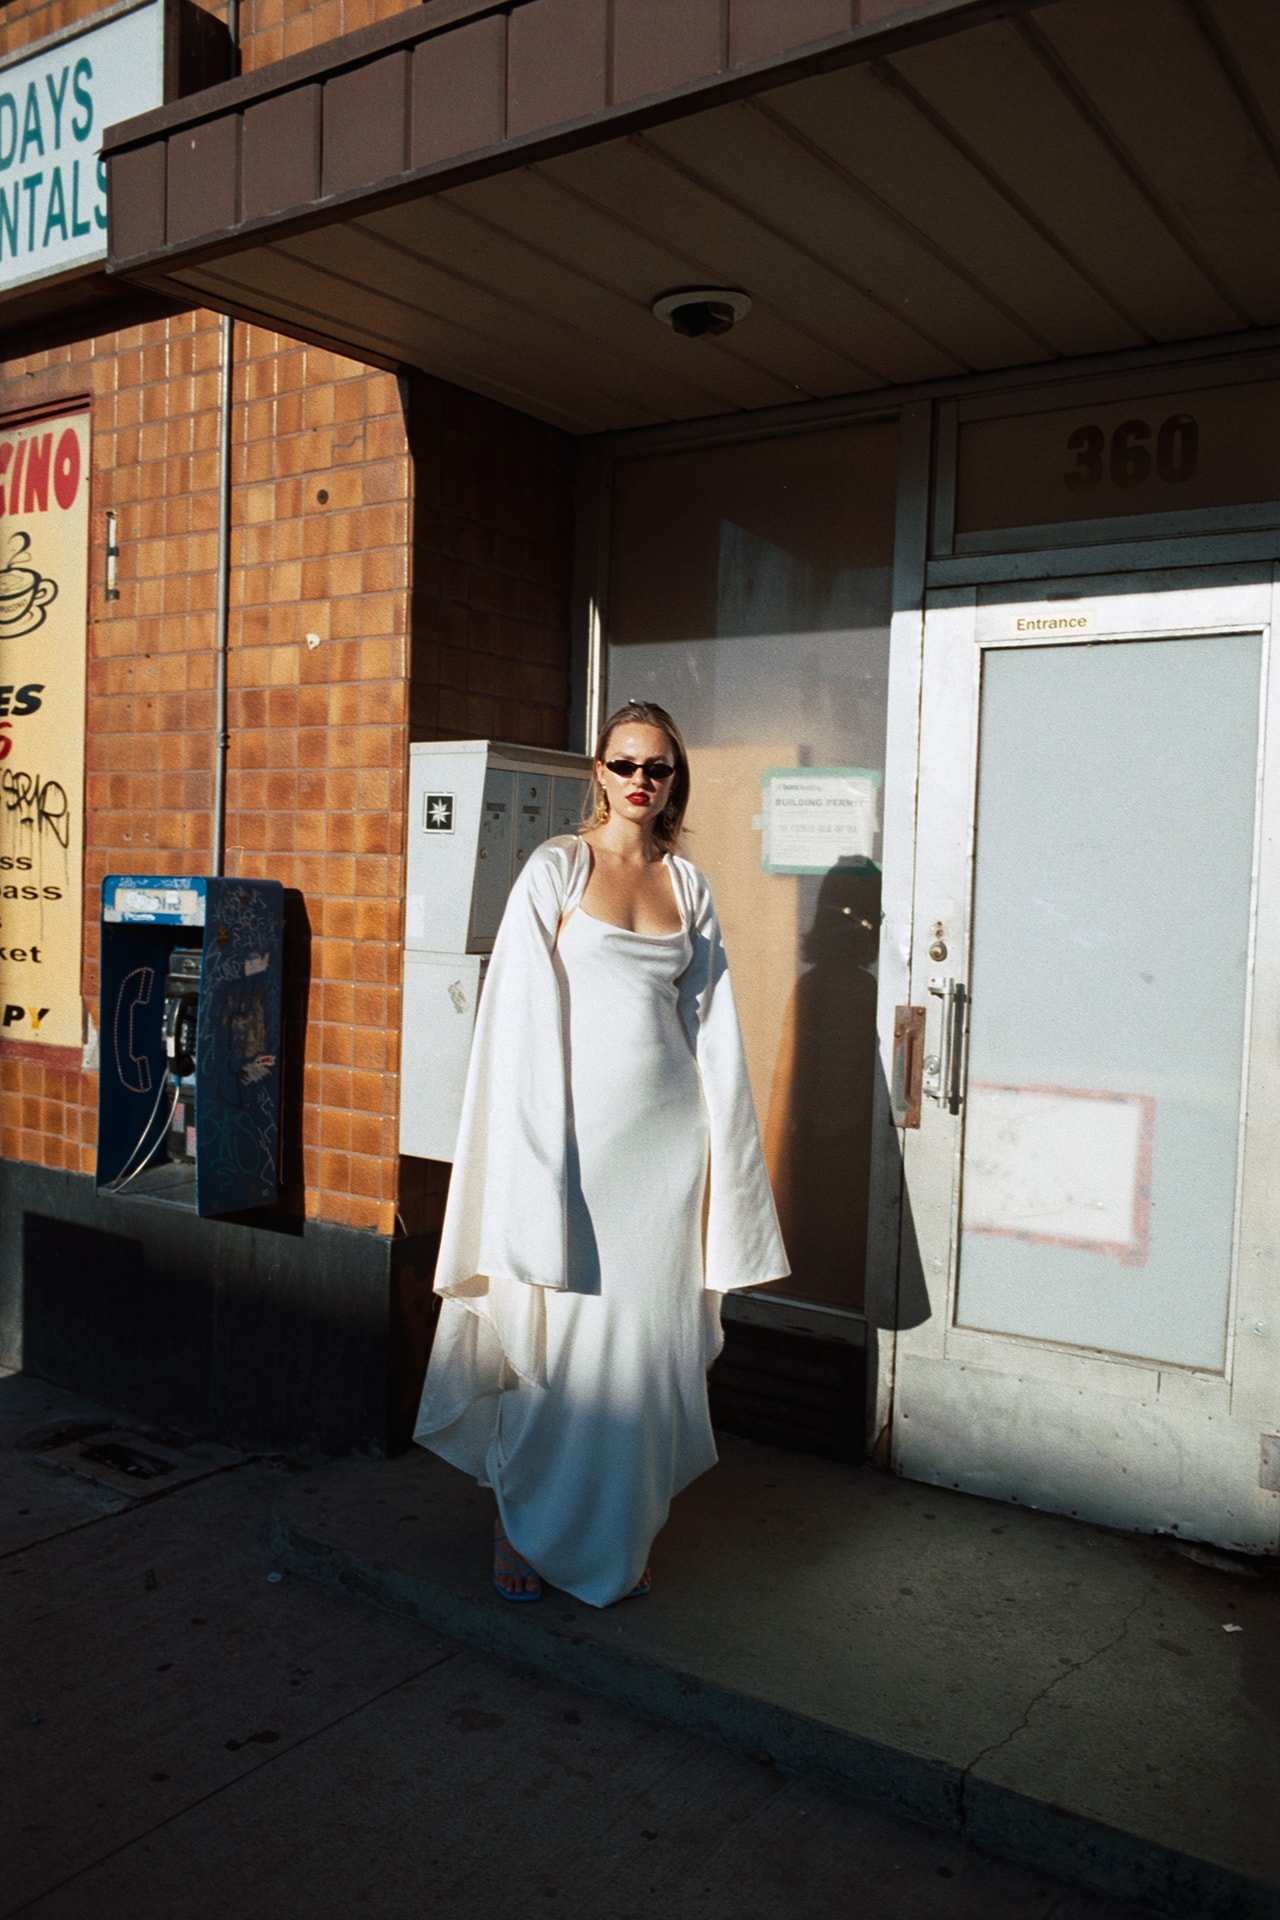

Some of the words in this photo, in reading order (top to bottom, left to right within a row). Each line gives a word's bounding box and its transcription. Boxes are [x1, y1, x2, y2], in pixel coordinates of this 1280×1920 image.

[0, 57, 93, 171] DAYS
[1063, 413, 1199, 493] 360
[1016, 615, 1087, 631] Entrance
[775, 798, 823, 807] BUILDING
[0, 885, 63, 901] ass
